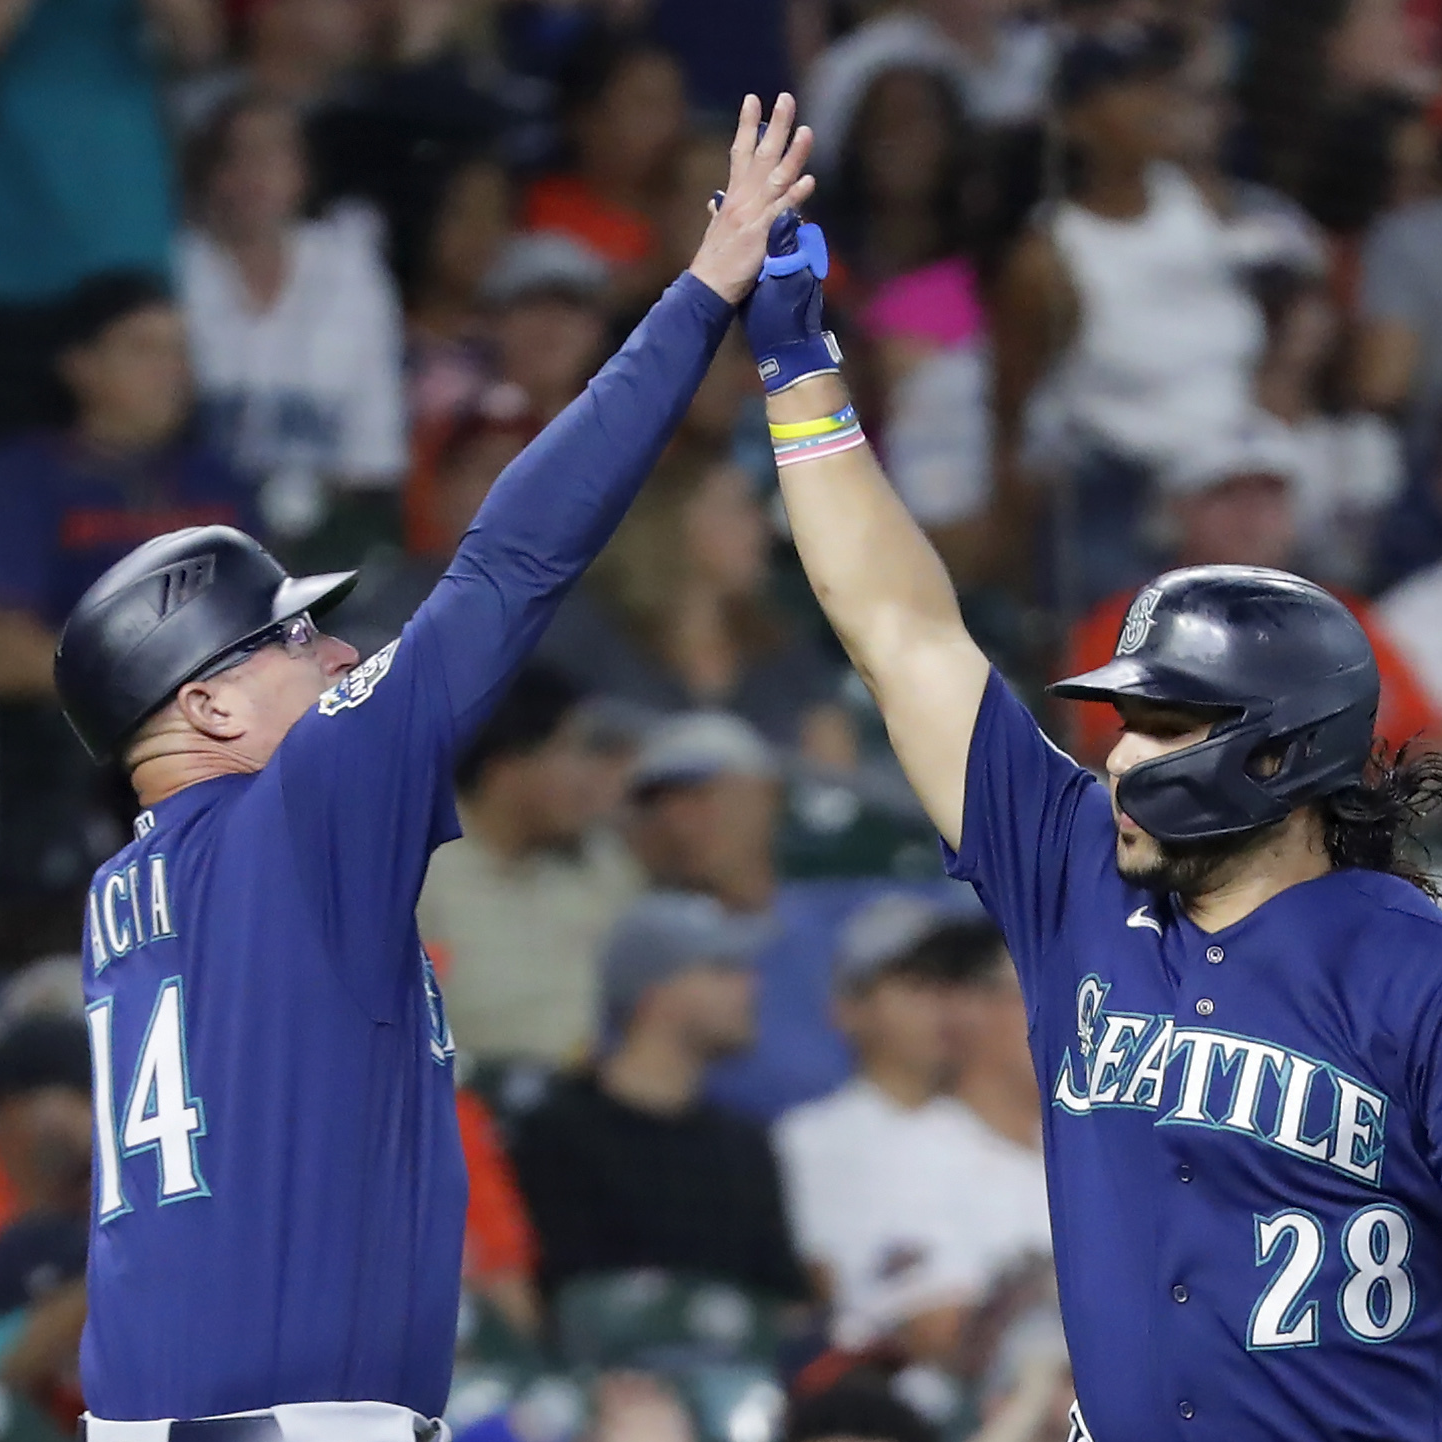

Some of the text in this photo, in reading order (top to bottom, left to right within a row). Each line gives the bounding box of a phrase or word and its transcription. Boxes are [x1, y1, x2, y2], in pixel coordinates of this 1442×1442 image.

[85, 975, 212, 1225] 14
[1052, 972, 1389, 1188] SEATTLE
[1246, 1203, 1416, 1351] 28
